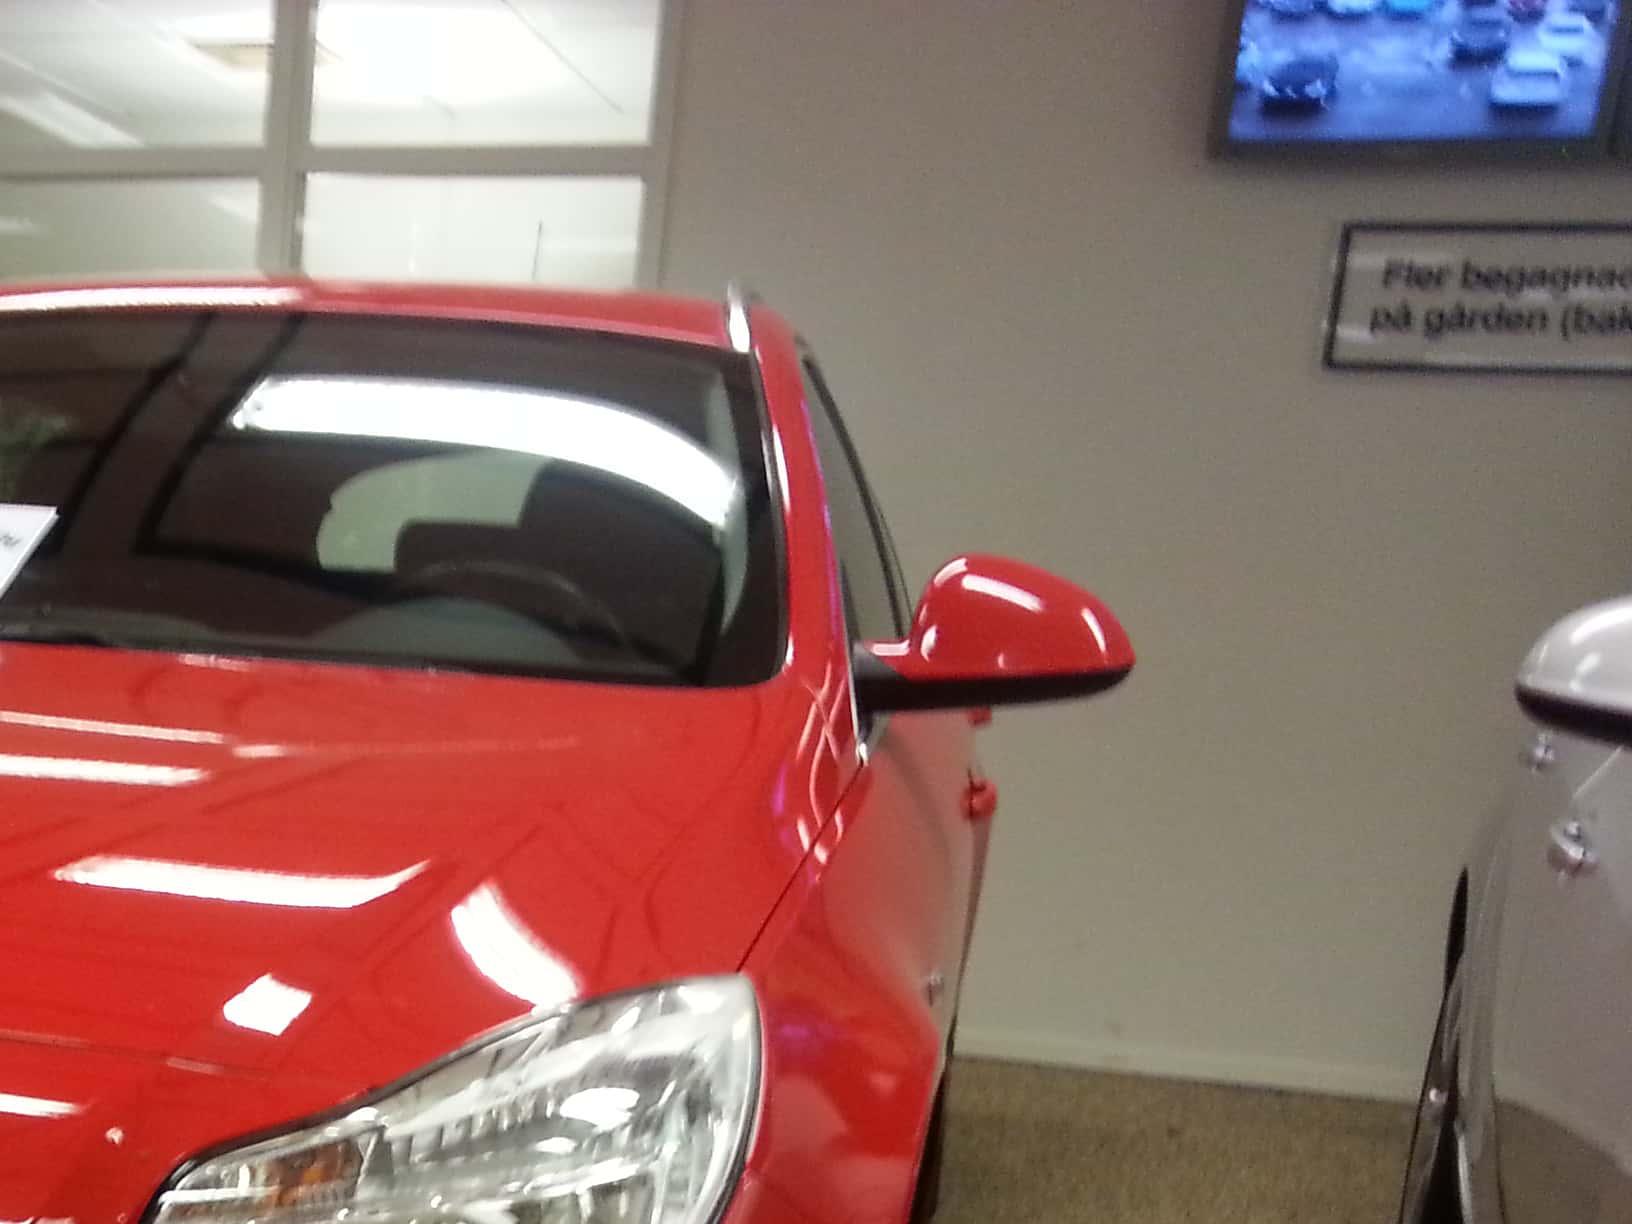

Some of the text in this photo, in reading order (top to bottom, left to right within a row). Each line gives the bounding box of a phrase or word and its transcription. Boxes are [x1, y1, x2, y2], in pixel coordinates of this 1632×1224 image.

[1383, 256, 1451, 288] Fler
[1369, 300, 1413, 336] på
[1423, 300, 1548, 341] gården
